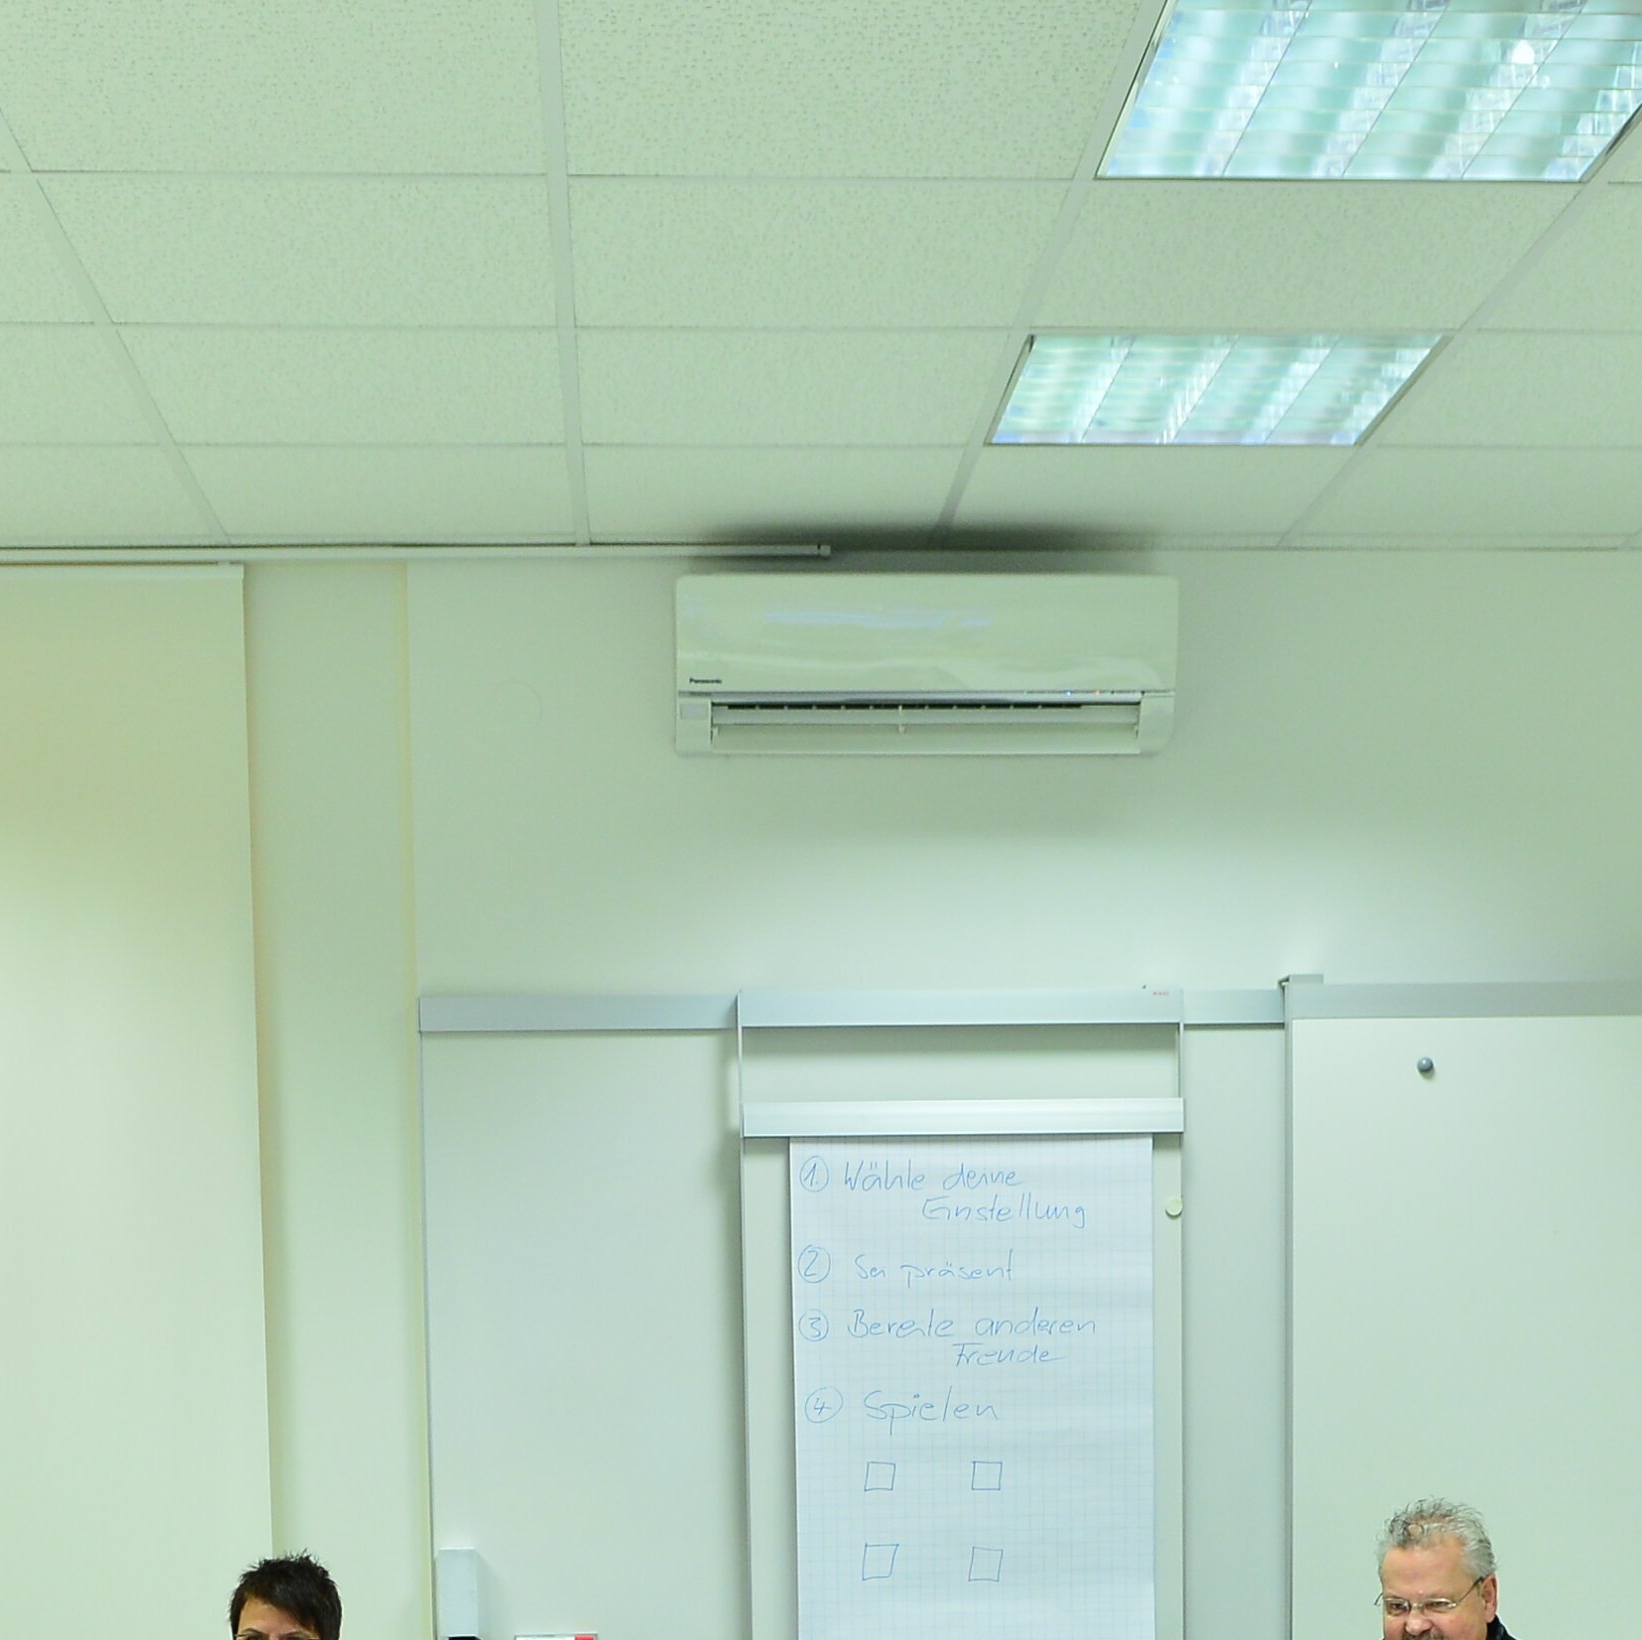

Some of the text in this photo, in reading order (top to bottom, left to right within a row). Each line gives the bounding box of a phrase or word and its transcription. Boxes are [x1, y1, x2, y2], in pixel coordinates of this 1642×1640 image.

[844, 1159, 926, 1191] Wähle
[943, 1162, 1023, 1190] deine
[922, 1192, 1086, 1229] Einstellung
[900, 1249, 1014, 1288] präsent
[975, 1306, 1096, 1337] anderen
[864, 1385, 999, 1436] Spielen
